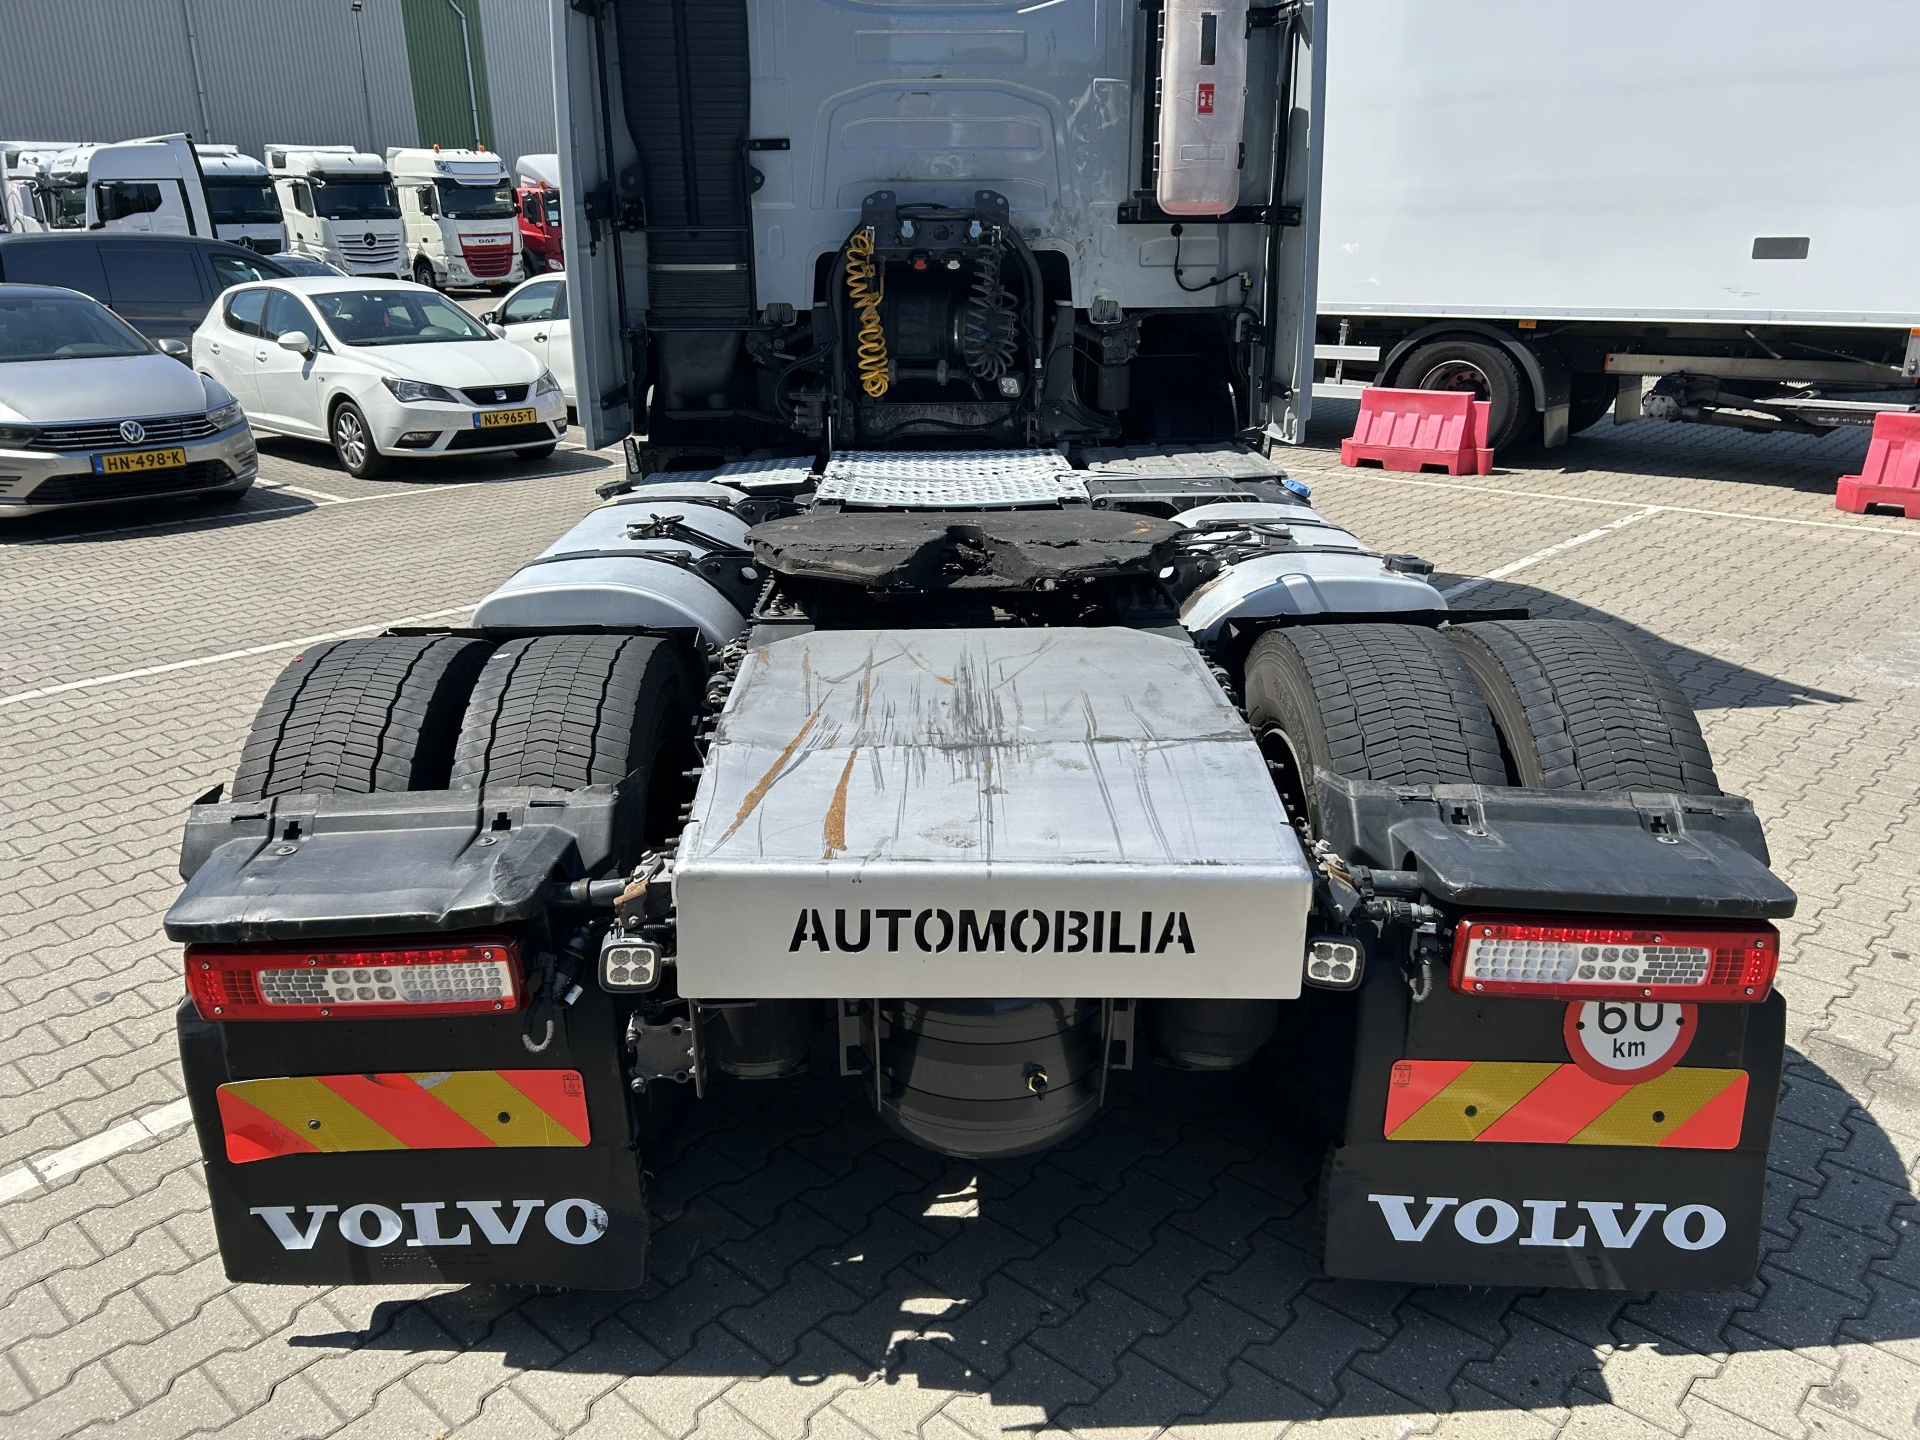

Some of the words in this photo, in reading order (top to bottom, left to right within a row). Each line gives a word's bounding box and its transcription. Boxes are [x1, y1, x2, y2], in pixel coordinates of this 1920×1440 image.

[484, 411, 532, 426] NX-965-T
[107, 451, 182, 471] HN-498-K
[788, 908, 1196, 955] AUTOMOBILIA
[1597, 1001, 1664, 1035] 60
[1612, 1037, 1645, 1059] km
[249, 1197, 609, 1250] VOLVO
[1367, 1193, 1726, 1251] VOLVO
